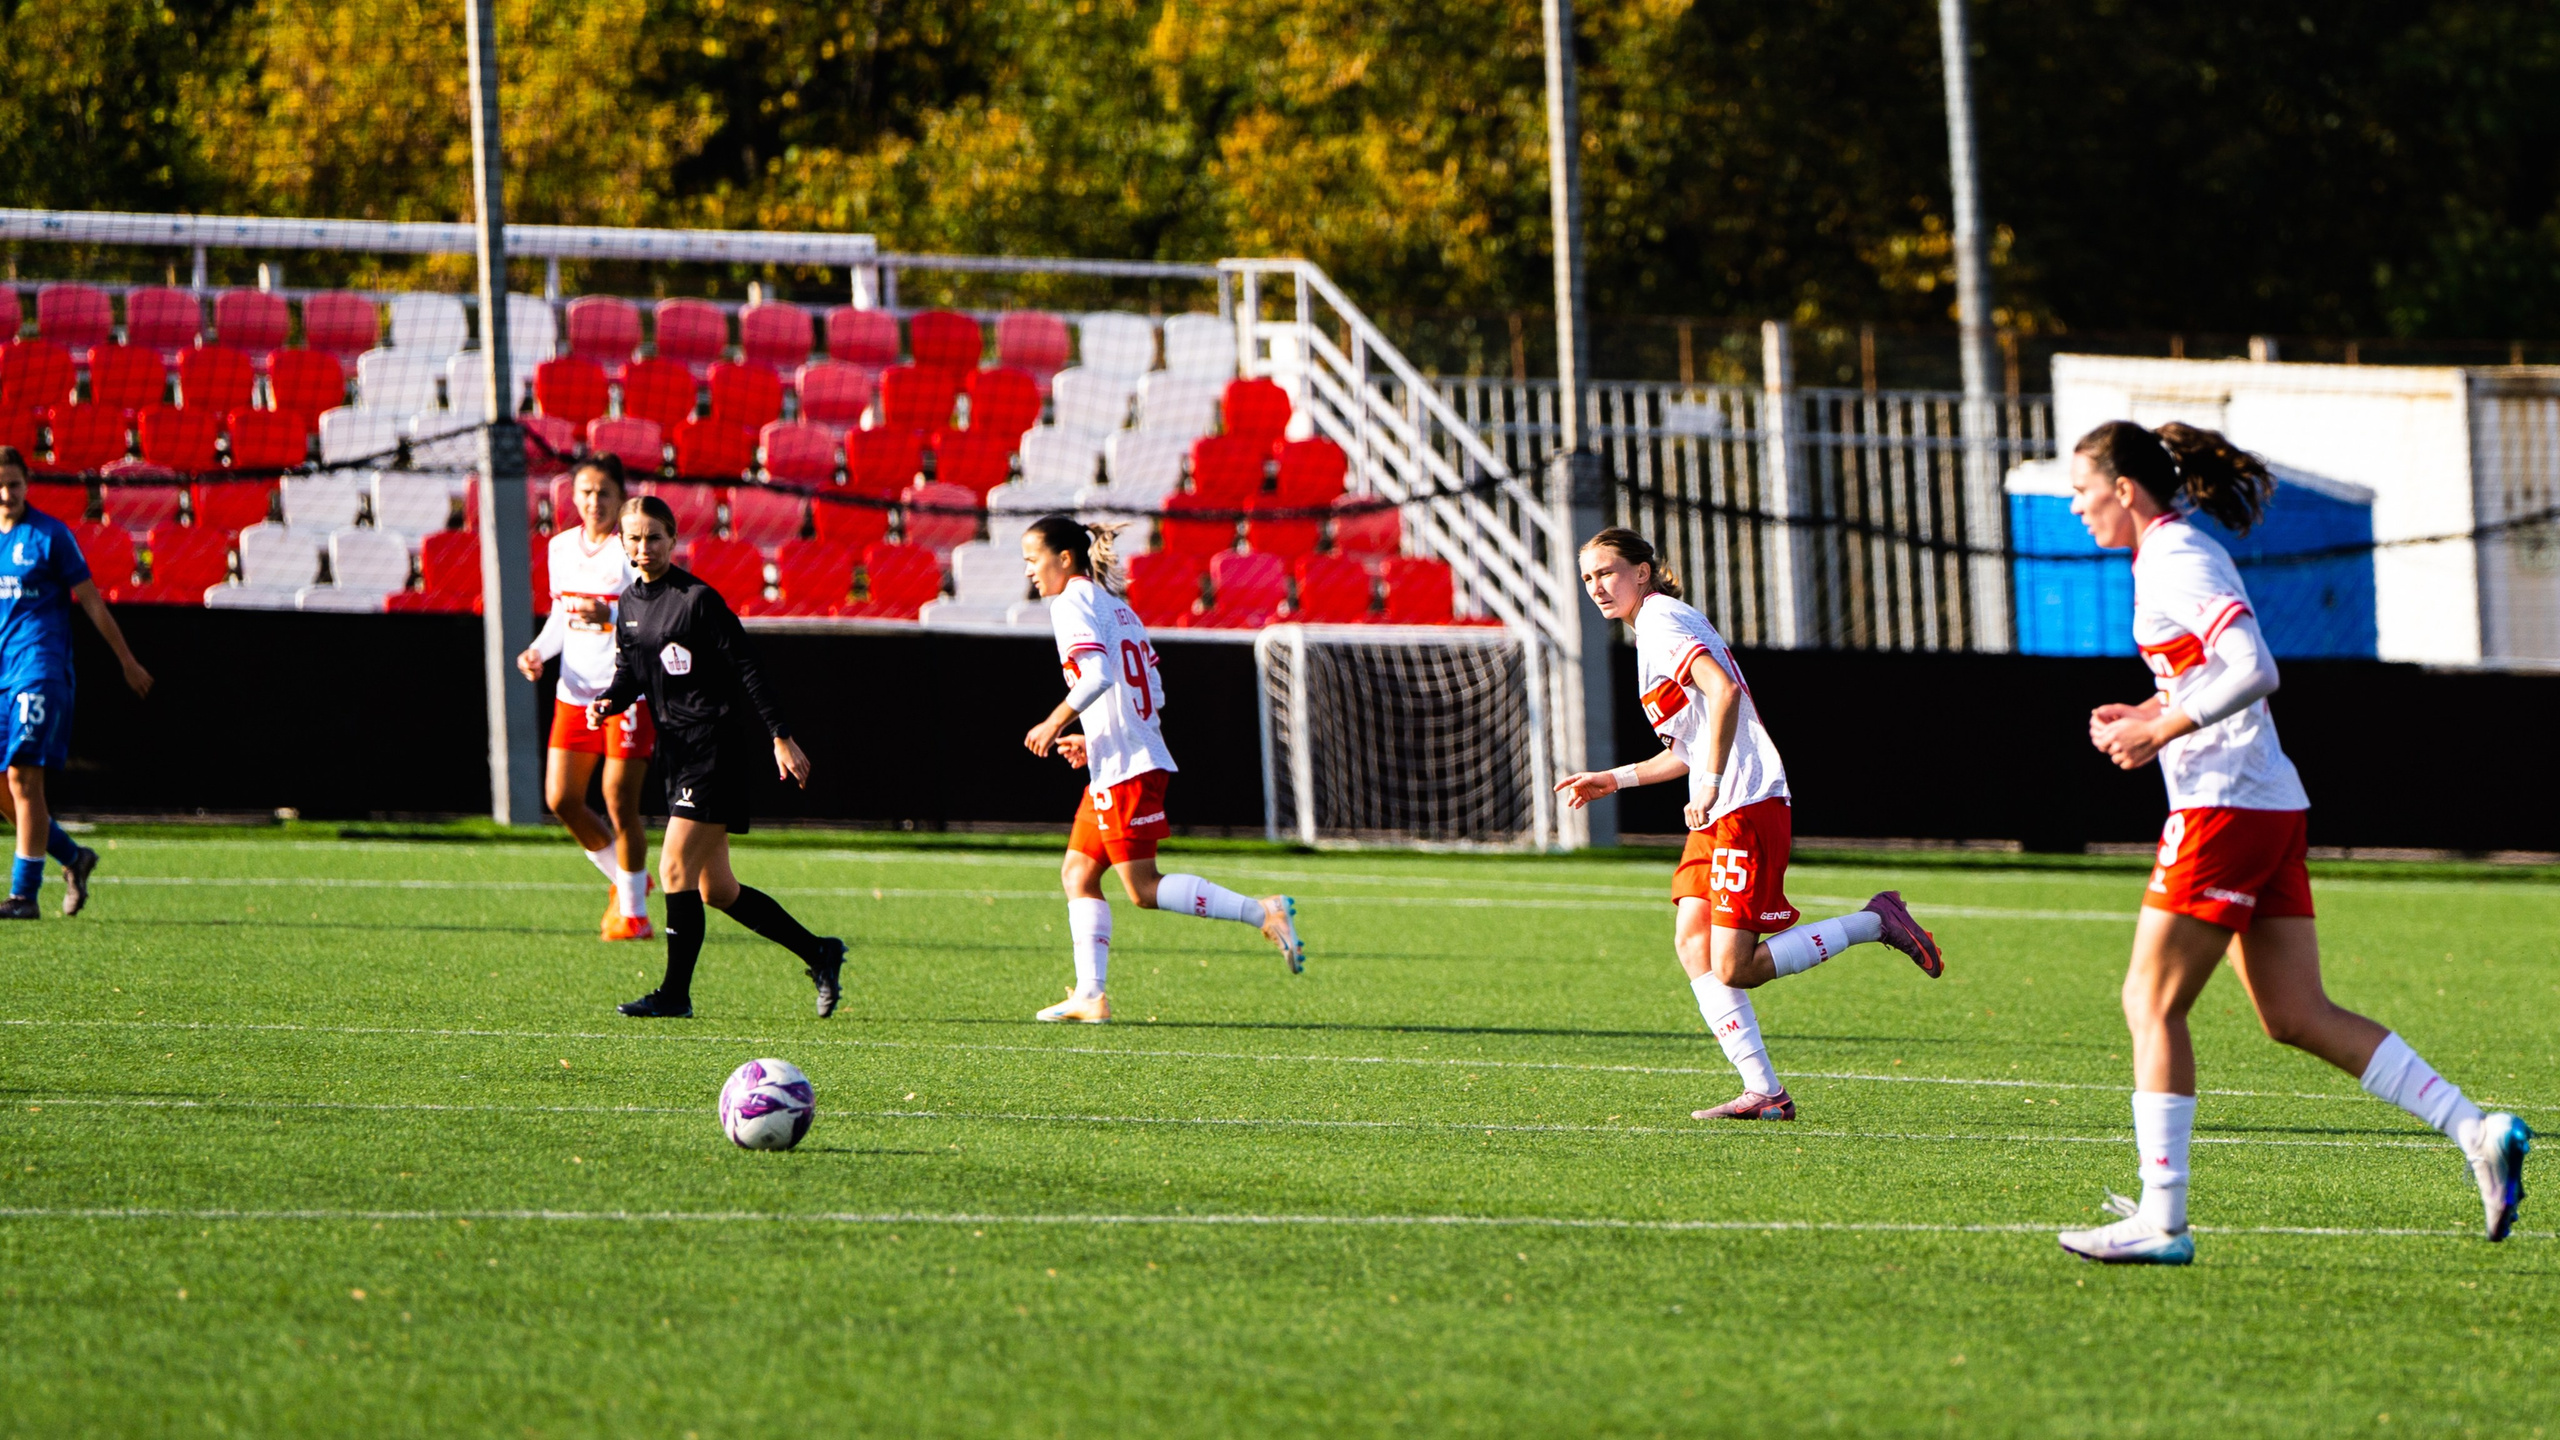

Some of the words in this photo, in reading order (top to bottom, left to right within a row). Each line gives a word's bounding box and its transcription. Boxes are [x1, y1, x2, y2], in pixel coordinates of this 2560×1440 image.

[17, 692, 46, 725] 13
[2158, 812, 2186, 867] 9
[1710, 847, 1748, 893] 55
